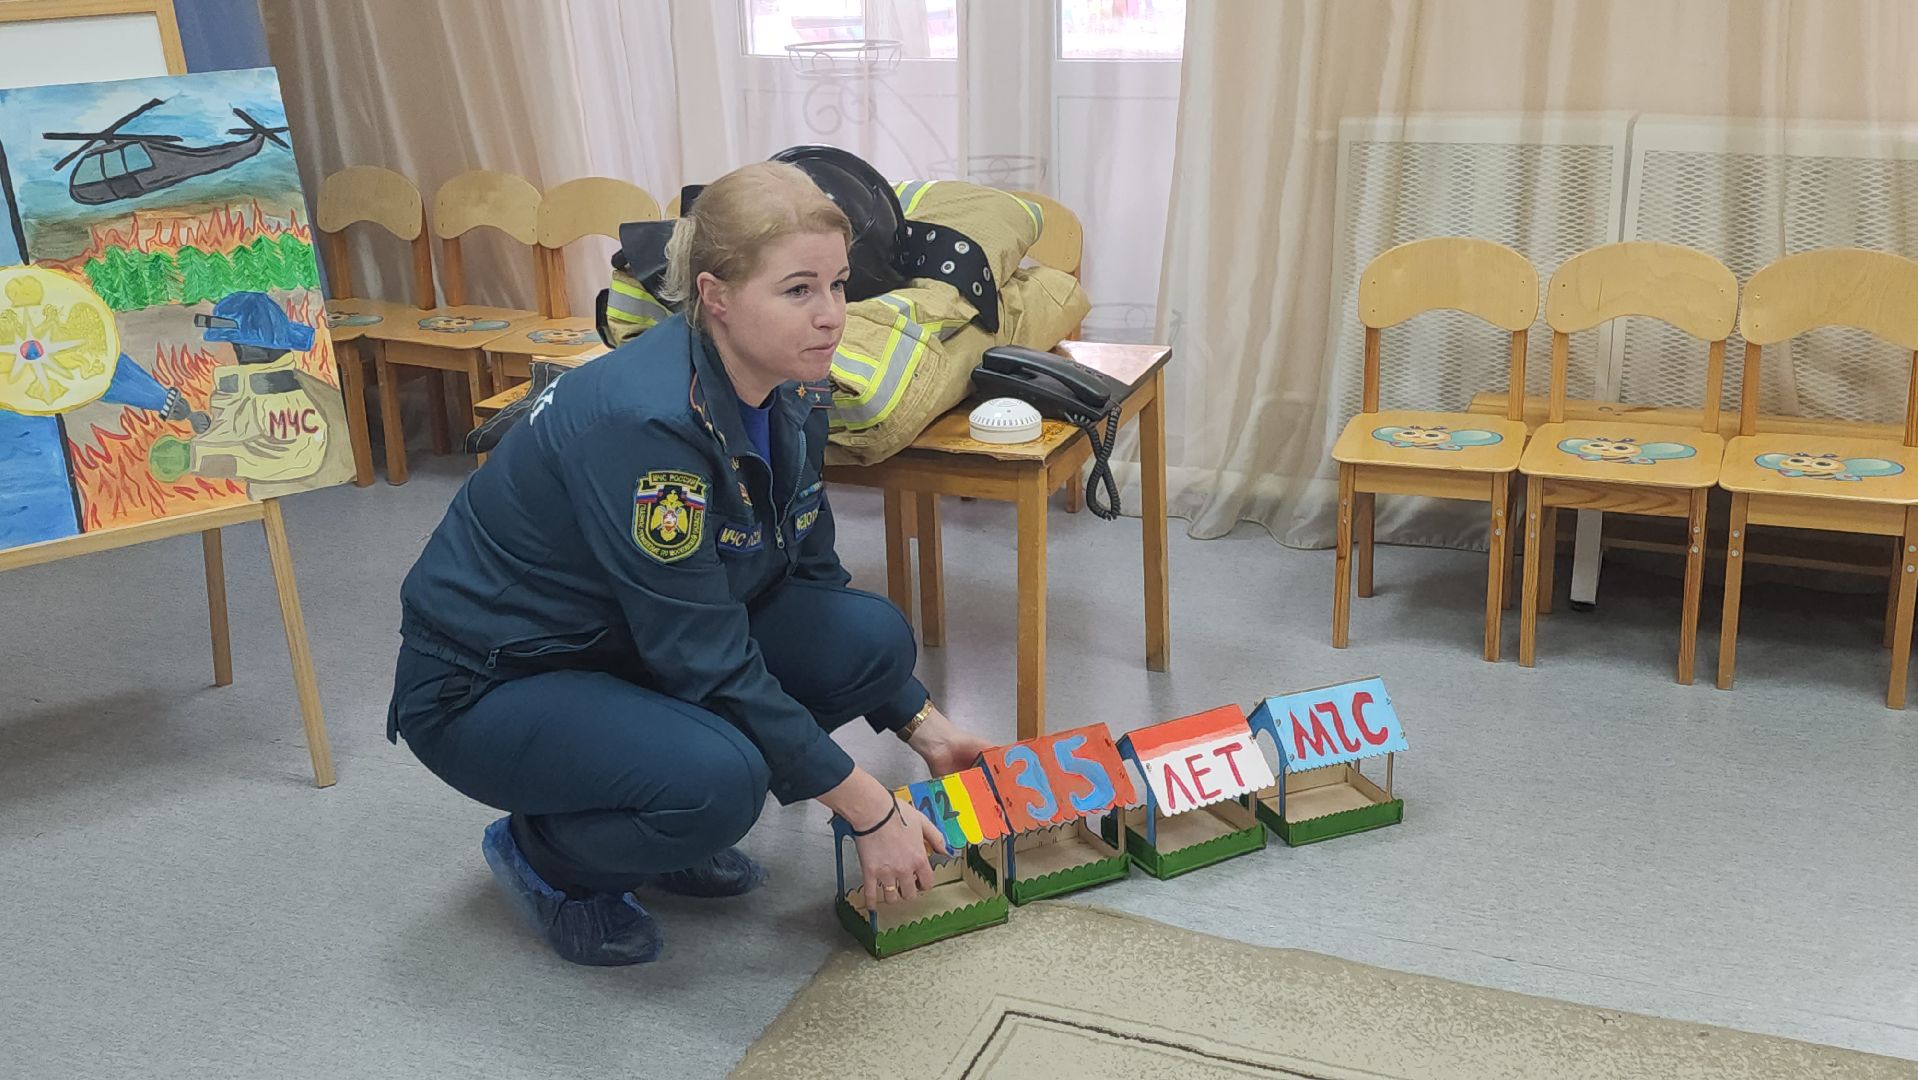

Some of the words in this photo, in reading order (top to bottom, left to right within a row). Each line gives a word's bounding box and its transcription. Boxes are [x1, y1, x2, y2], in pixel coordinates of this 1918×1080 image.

[268, 408, 319, 439] МЧС
[719, 527, 746, 547] МЧС
[1004, 734, 1116, 821] 35
[1163, 742, 1244, 809] ЛЕТ
